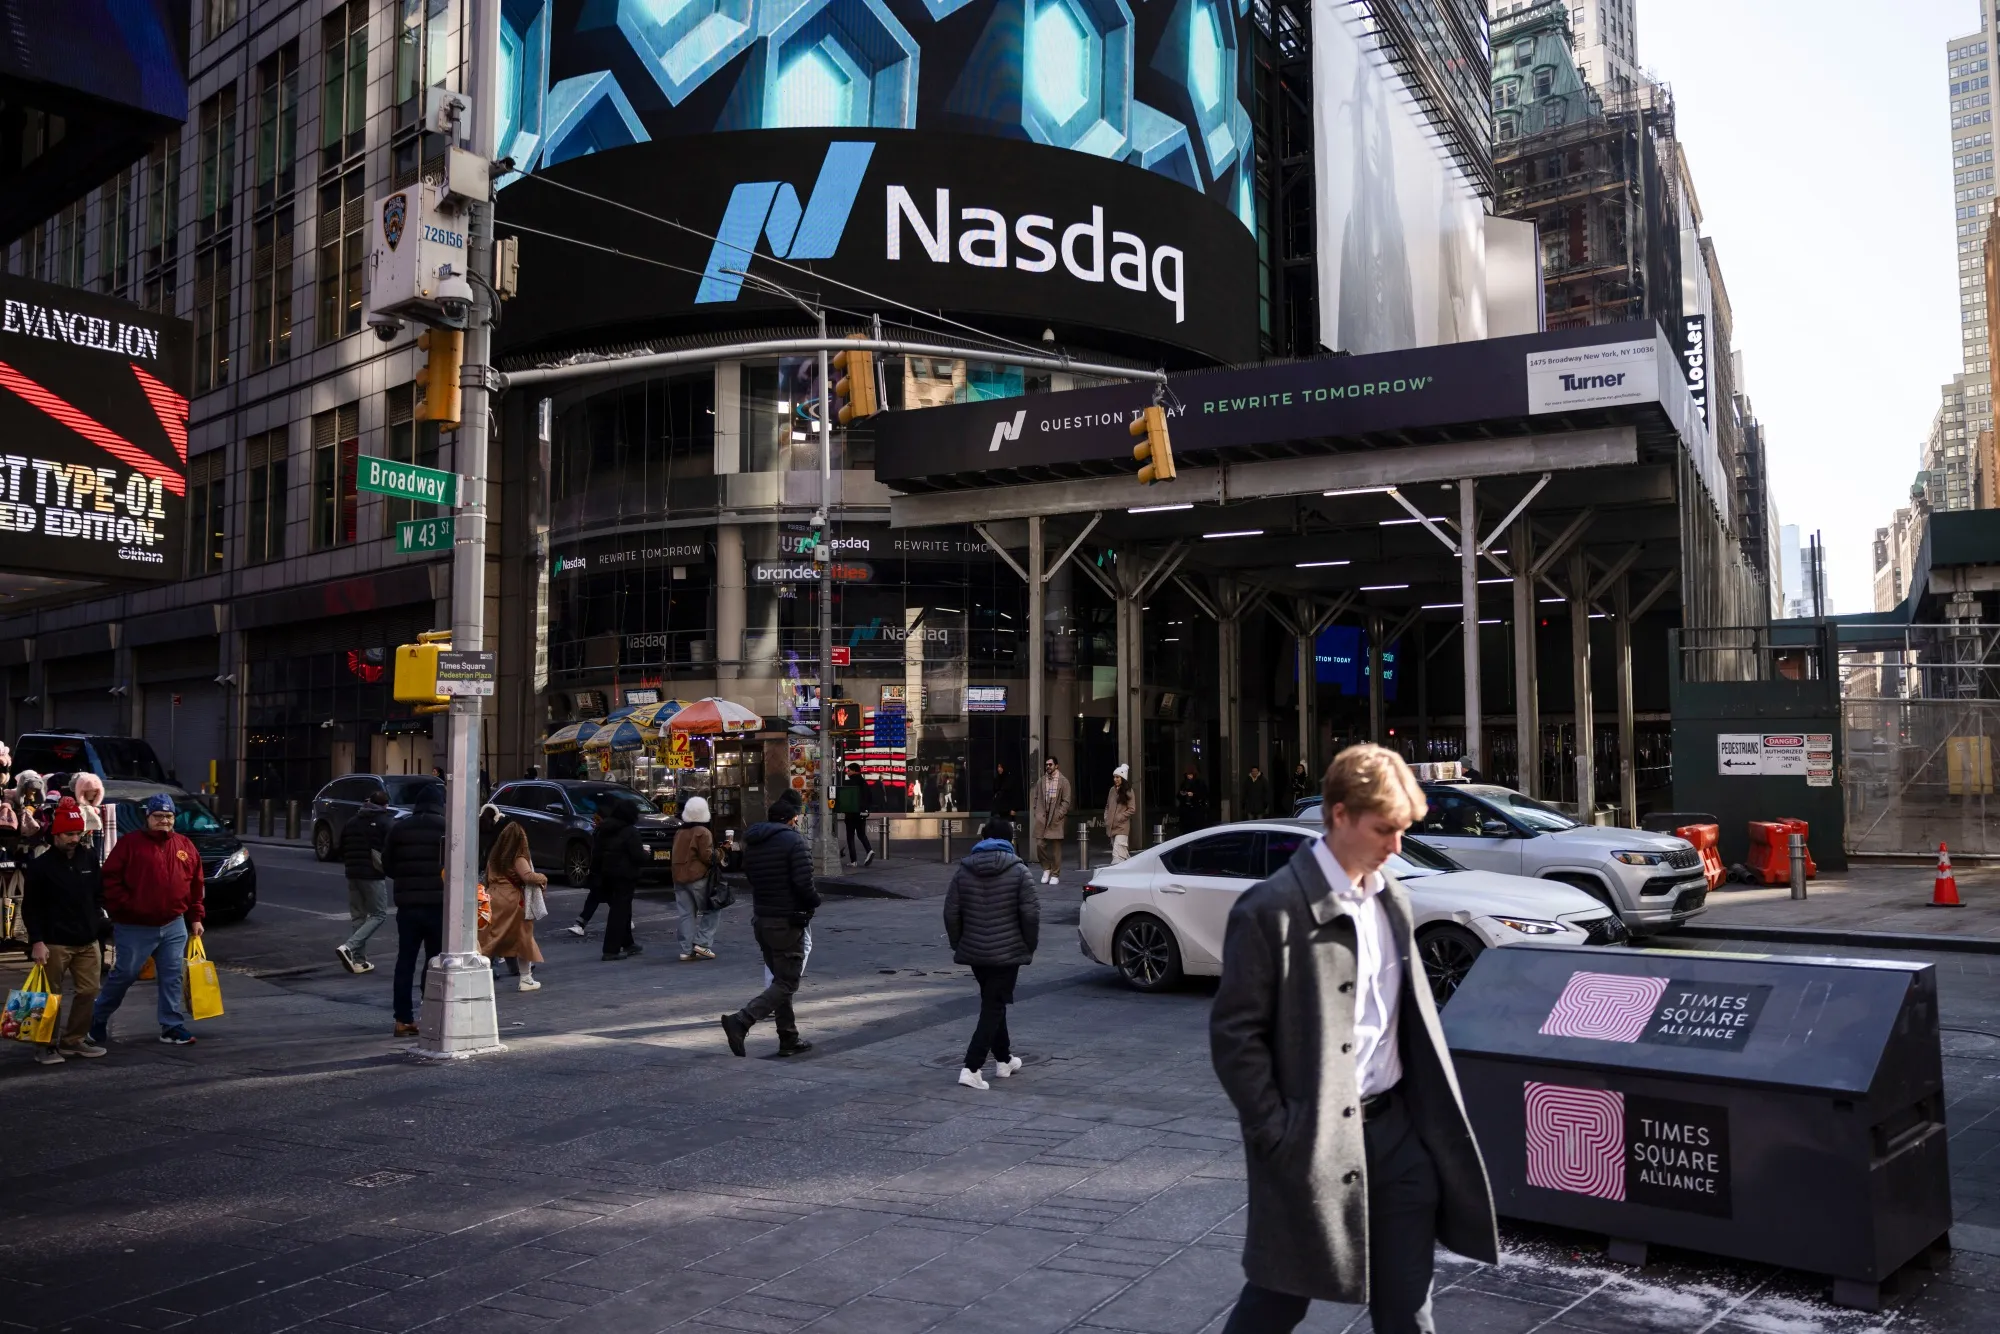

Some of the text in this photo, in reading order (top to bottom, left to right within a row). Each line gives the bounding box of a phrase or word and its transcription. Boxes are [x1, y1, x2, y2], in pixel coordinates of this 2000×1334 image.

[886, 184, 1185, 324] Nasdaq
[2, 299, 159, 360] EVANGELION
[1530, 358, 1547, 366] 1475
[1548, 355, 1582, 364] Broadway
[1601, 350, 1619, 358] York,
[1632, 345, 1655, 354] 10036
[1558, 372, 1626, 391] Turner
[1040, 412, 1123, 432] QUESTION
[1132, 404, 1187, 422] TAY
[1203, 392, 1293, 414] REWRITE
[32, 458, 166, 520] TYPE-01
[370, 461, 445, 502] Broadway
[403, 521, 449, 549] W 43 St
[831, 536, 987, 552] asdaq REWRITE TOMO
[562, 545, 702, 571] Nasdaq REWRITE TOMORROW
[882, 625, 948, 645] Nasdaq
[440, 661, 486, 671] Times Square
[440, 670, 492, 679] Pedestrian Plaza
[1721, 742, 1759, 755] PEDESTRIANS
[1679, 992, 1748, 1010] TIMES
[1660, 1007, 1749, 1027] SQUARE
[1657, 1023, 1737, 1039] ALLIANCE
[1640, 1118, 1710, 1146] TIMES
[1634, 1142, 1720, 1173] SQUARE
[1639, 1168, 1716, 1194] ALLIANCE
